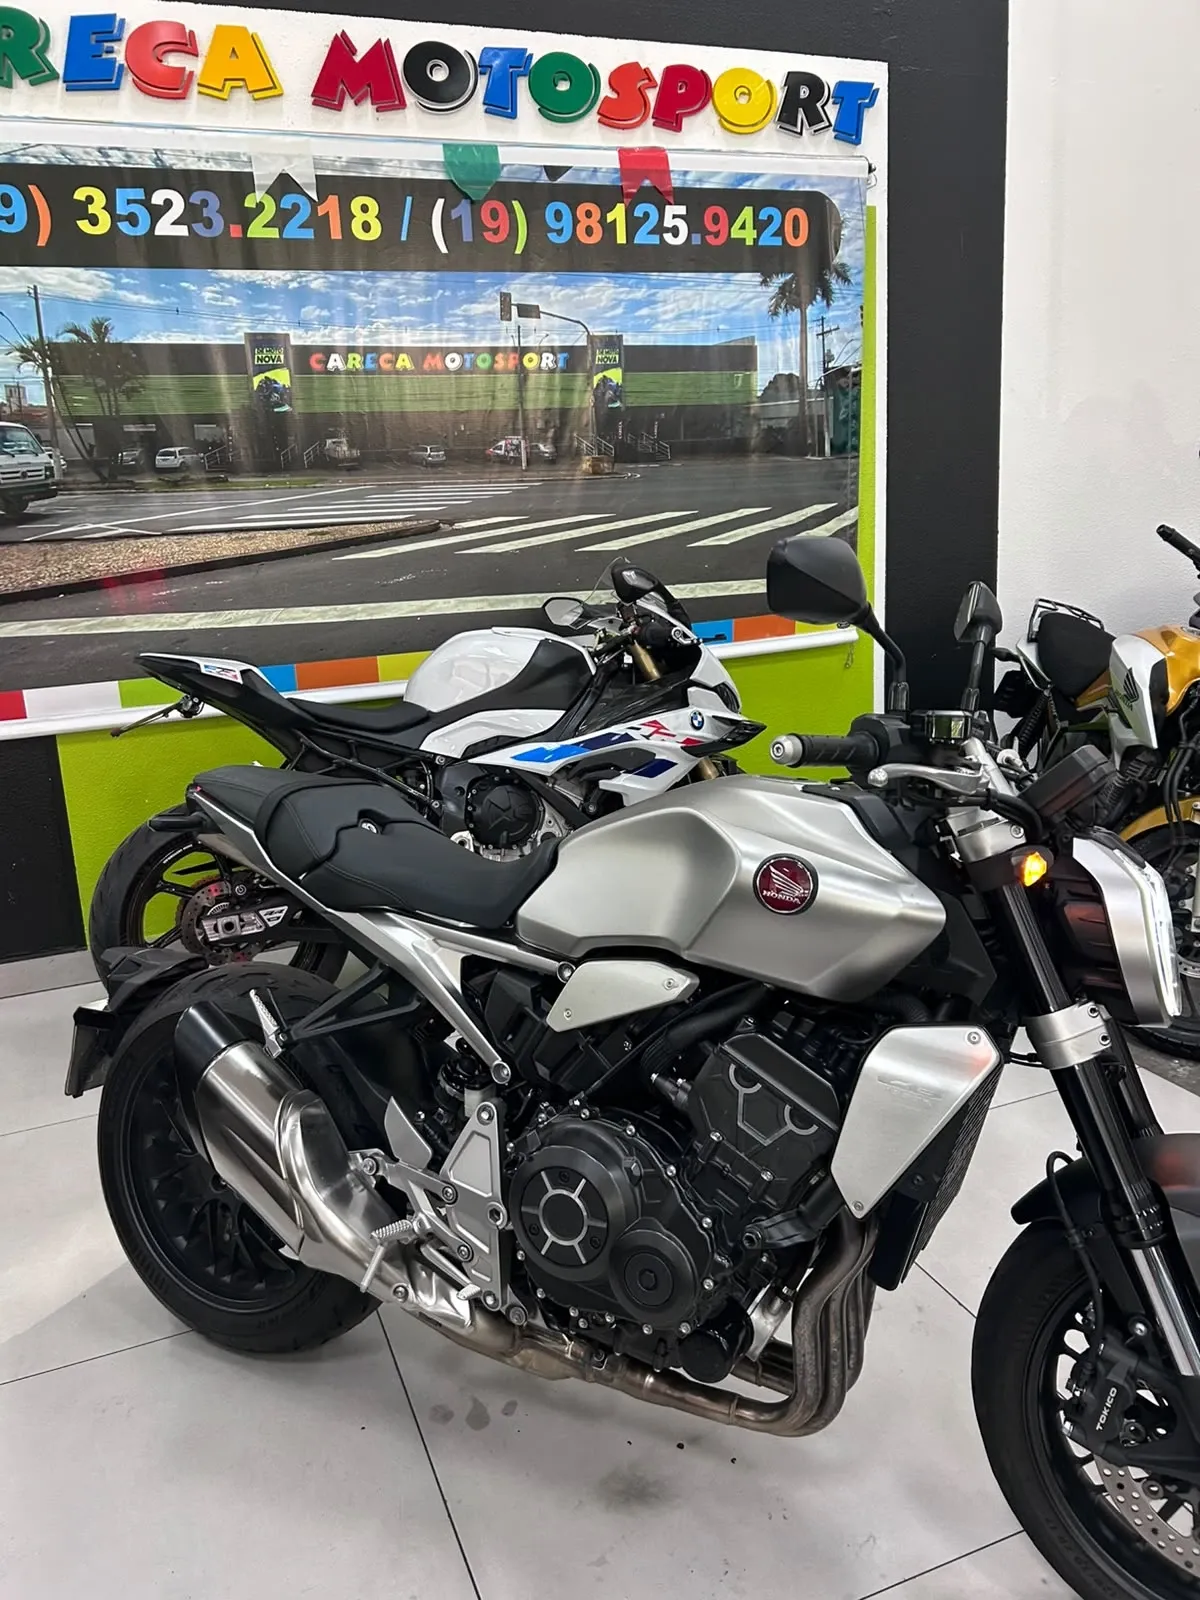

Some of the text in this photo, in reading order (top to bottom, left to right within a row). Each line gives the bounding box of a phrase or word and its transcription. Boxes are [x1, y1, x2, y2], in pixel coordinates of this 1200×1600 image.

[0, 5, 880, 146] RECA MOTOSPORT
[0, 184, 809, 255] 9) 3523.2218 / (19) 98125.9420
[256, 355, 283, 364] NOVA
[309, 352, 569, 372] CARECA MOTOSPORT
[597, 355, 618, 364] NOVA
[762, 889, 802, 905] HONDA
[1095, 1387, 1118, 1431] TOKICO
